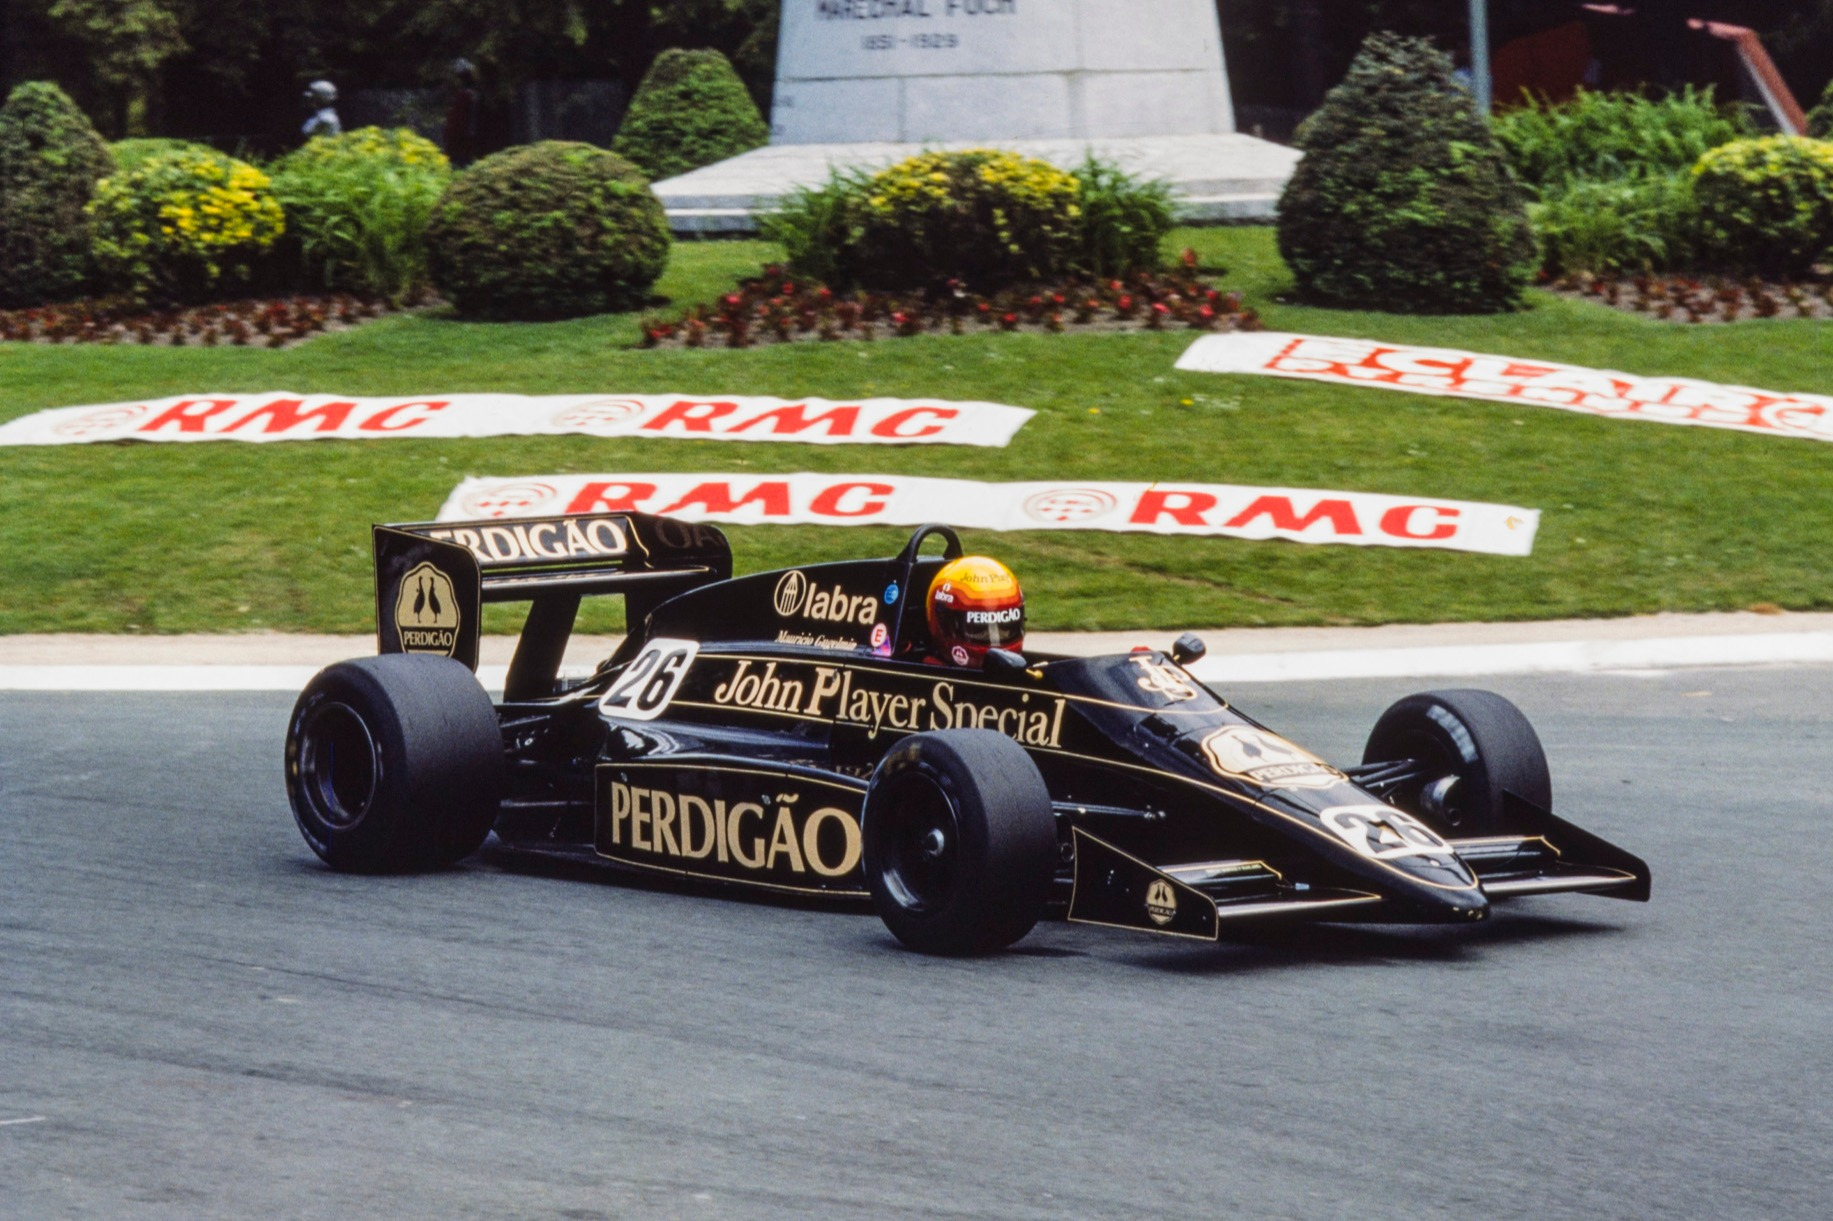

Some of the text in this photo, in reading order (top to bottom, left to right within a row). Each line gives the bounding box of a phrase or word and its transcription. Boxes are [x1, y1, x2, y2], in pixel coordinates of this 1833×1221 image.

[138, 399, 451, 433] RMC
[641, 400, 960, 438] RMC
[564, 480, 896, 517] RMC
[1128, 490, 1462, 540] RMC
[803, 582, 878, 625] labra
[403, 630, 453, 647] PERDIGÃO
[601, 649, 688, 711] 26
[714, 659, 1066, 748] John Player Special
[611, 781, 862, 877] PERDIGÃO
[1333, 811, 1444, 855] 26
